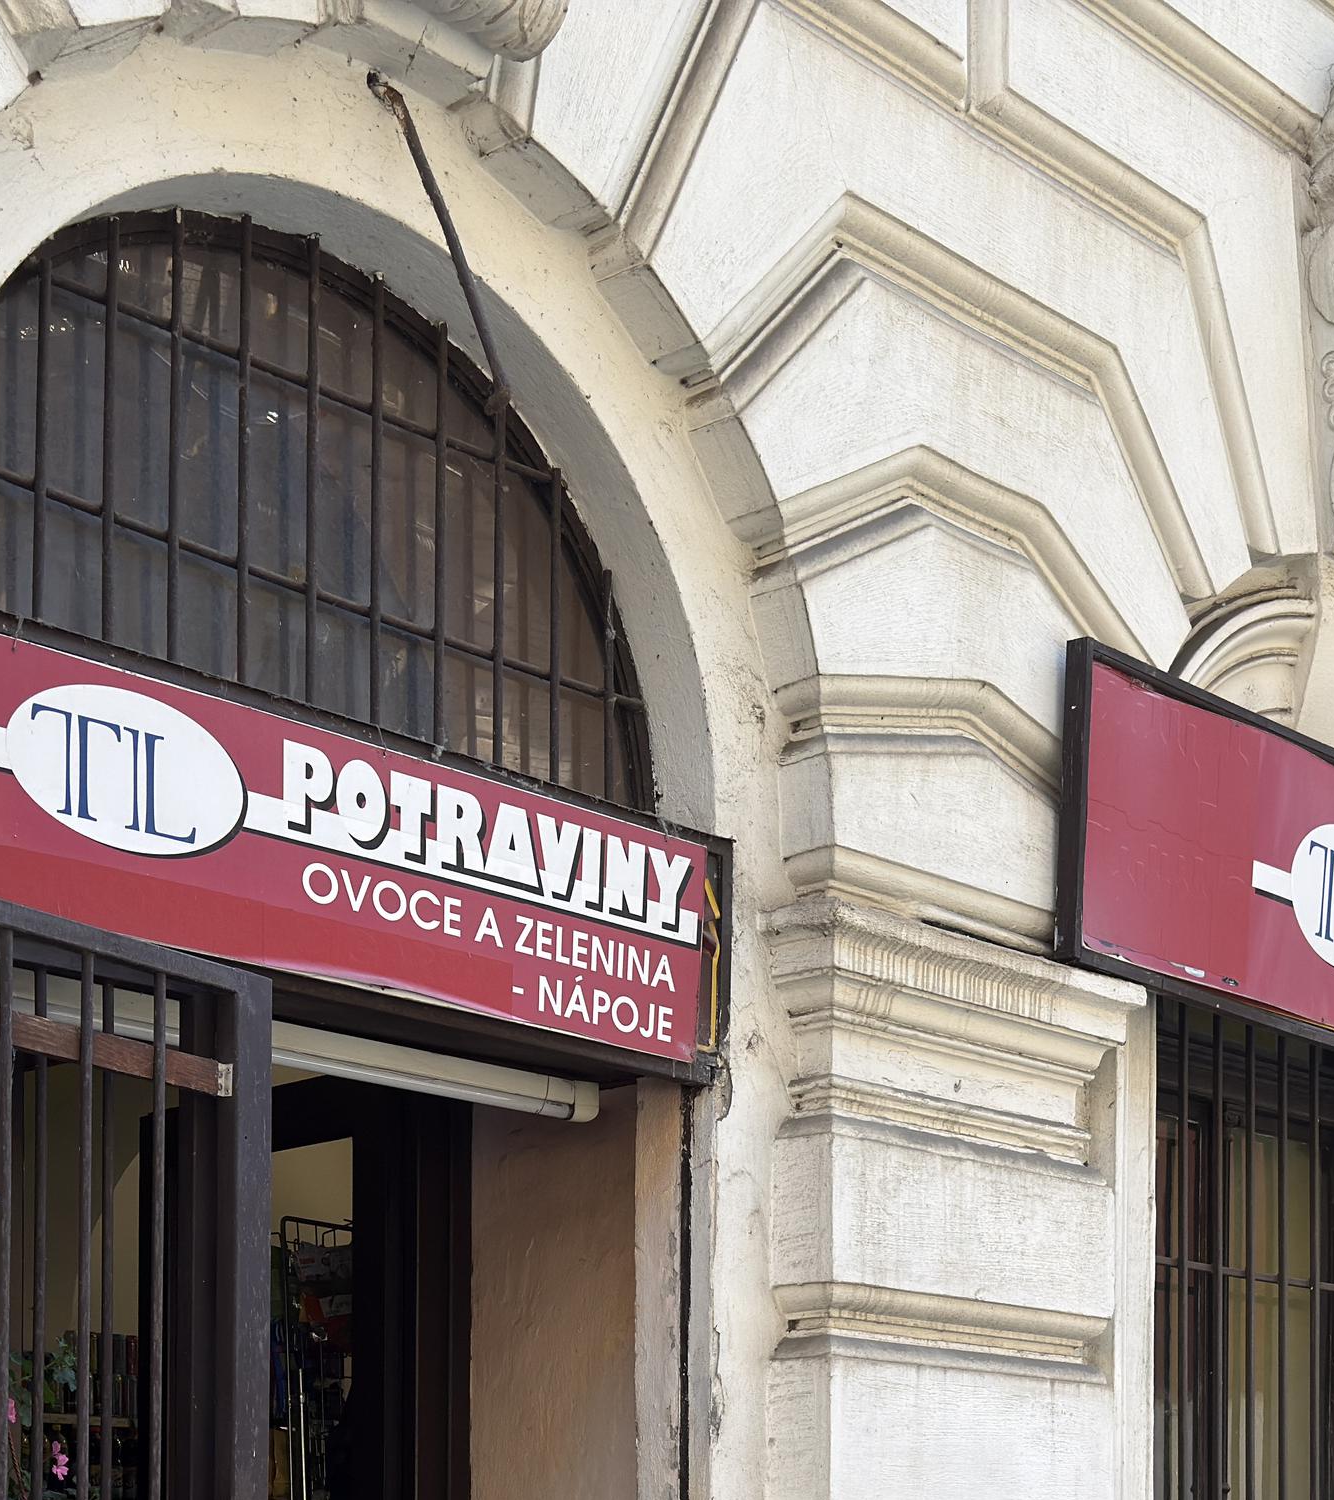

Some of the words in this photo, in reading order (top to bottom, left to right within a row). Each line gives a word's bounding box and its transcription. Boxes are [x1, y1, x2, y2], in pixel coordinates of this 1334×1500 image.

[31, 703, 196, 844] TL
[283, 738, 694, 936] POTRAVINY
[302, 862, 462, 938] OVOCE
[474, 907, 503, 948] A
[514, 915, 675, 992] ZELENINA
[538, 976, 673, 1042] NÁPOJE
